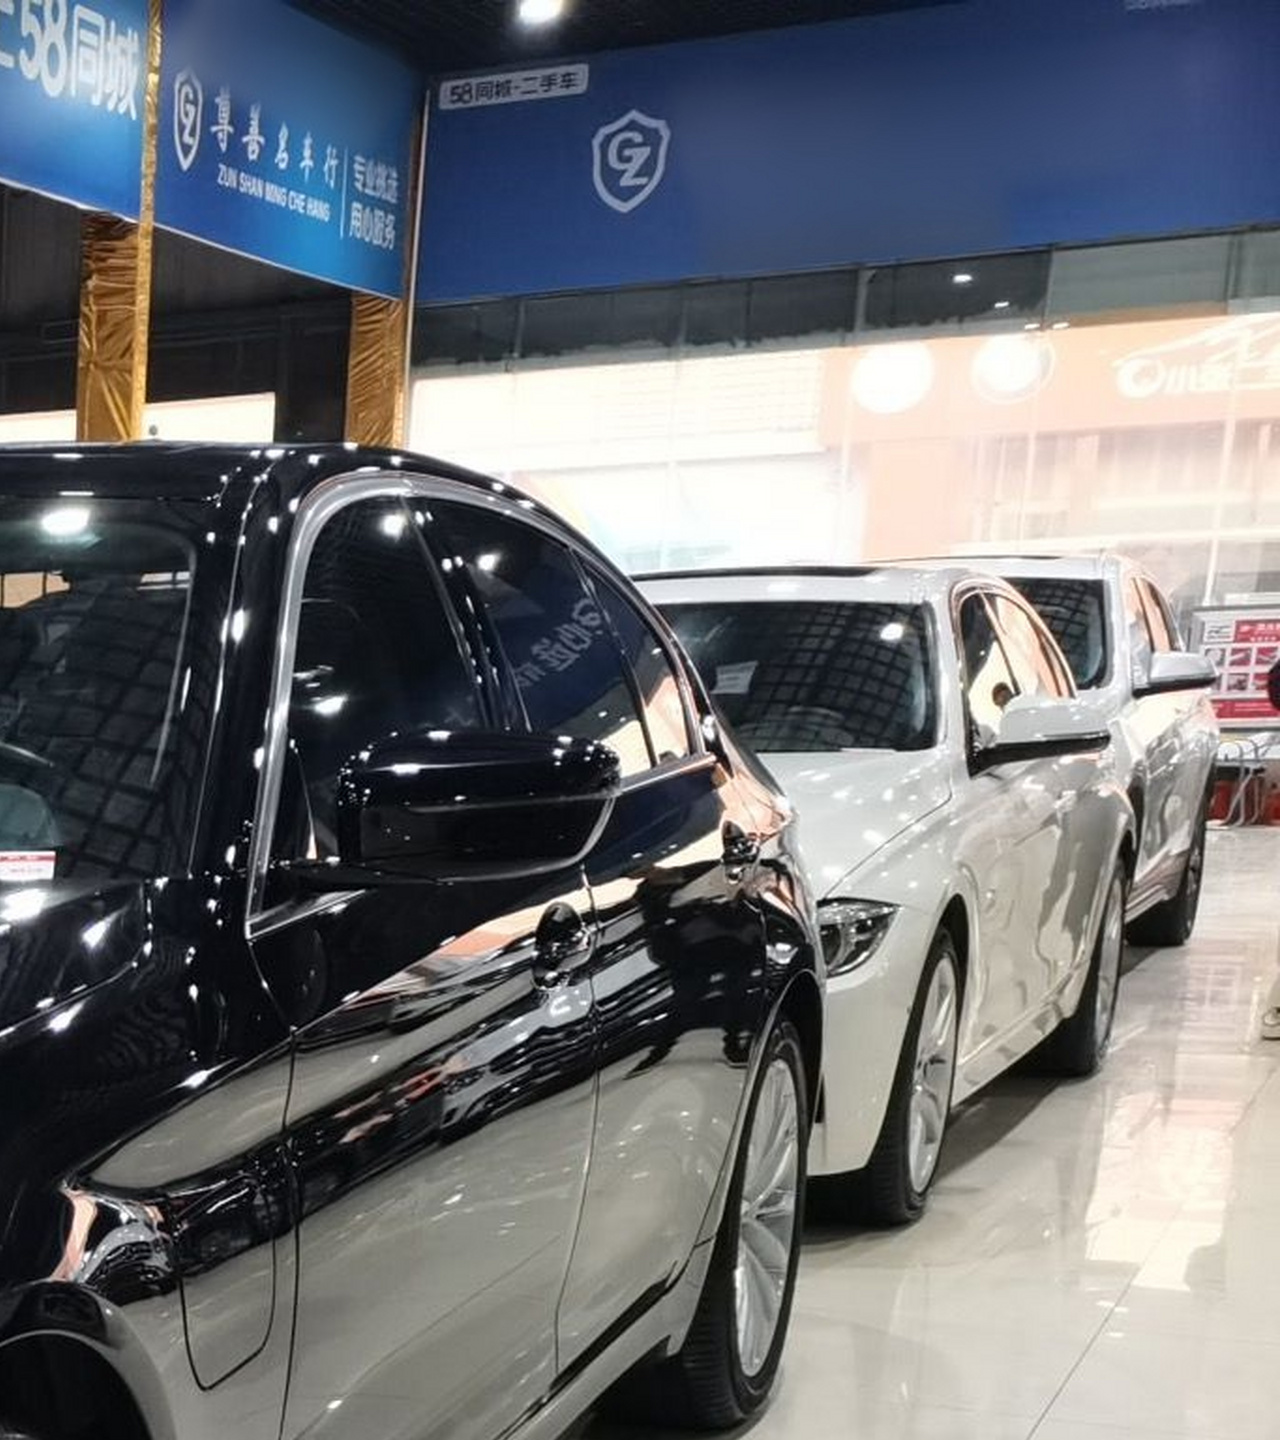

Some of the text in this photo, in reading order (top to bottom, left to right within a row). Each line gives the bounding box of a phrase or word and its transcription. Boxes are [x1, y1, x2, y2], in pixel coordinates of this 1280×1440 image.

[218, 162, 331, 222] ZUN SHAN MING CHE HANG
[349, 201, 396, 250] 用心服务
